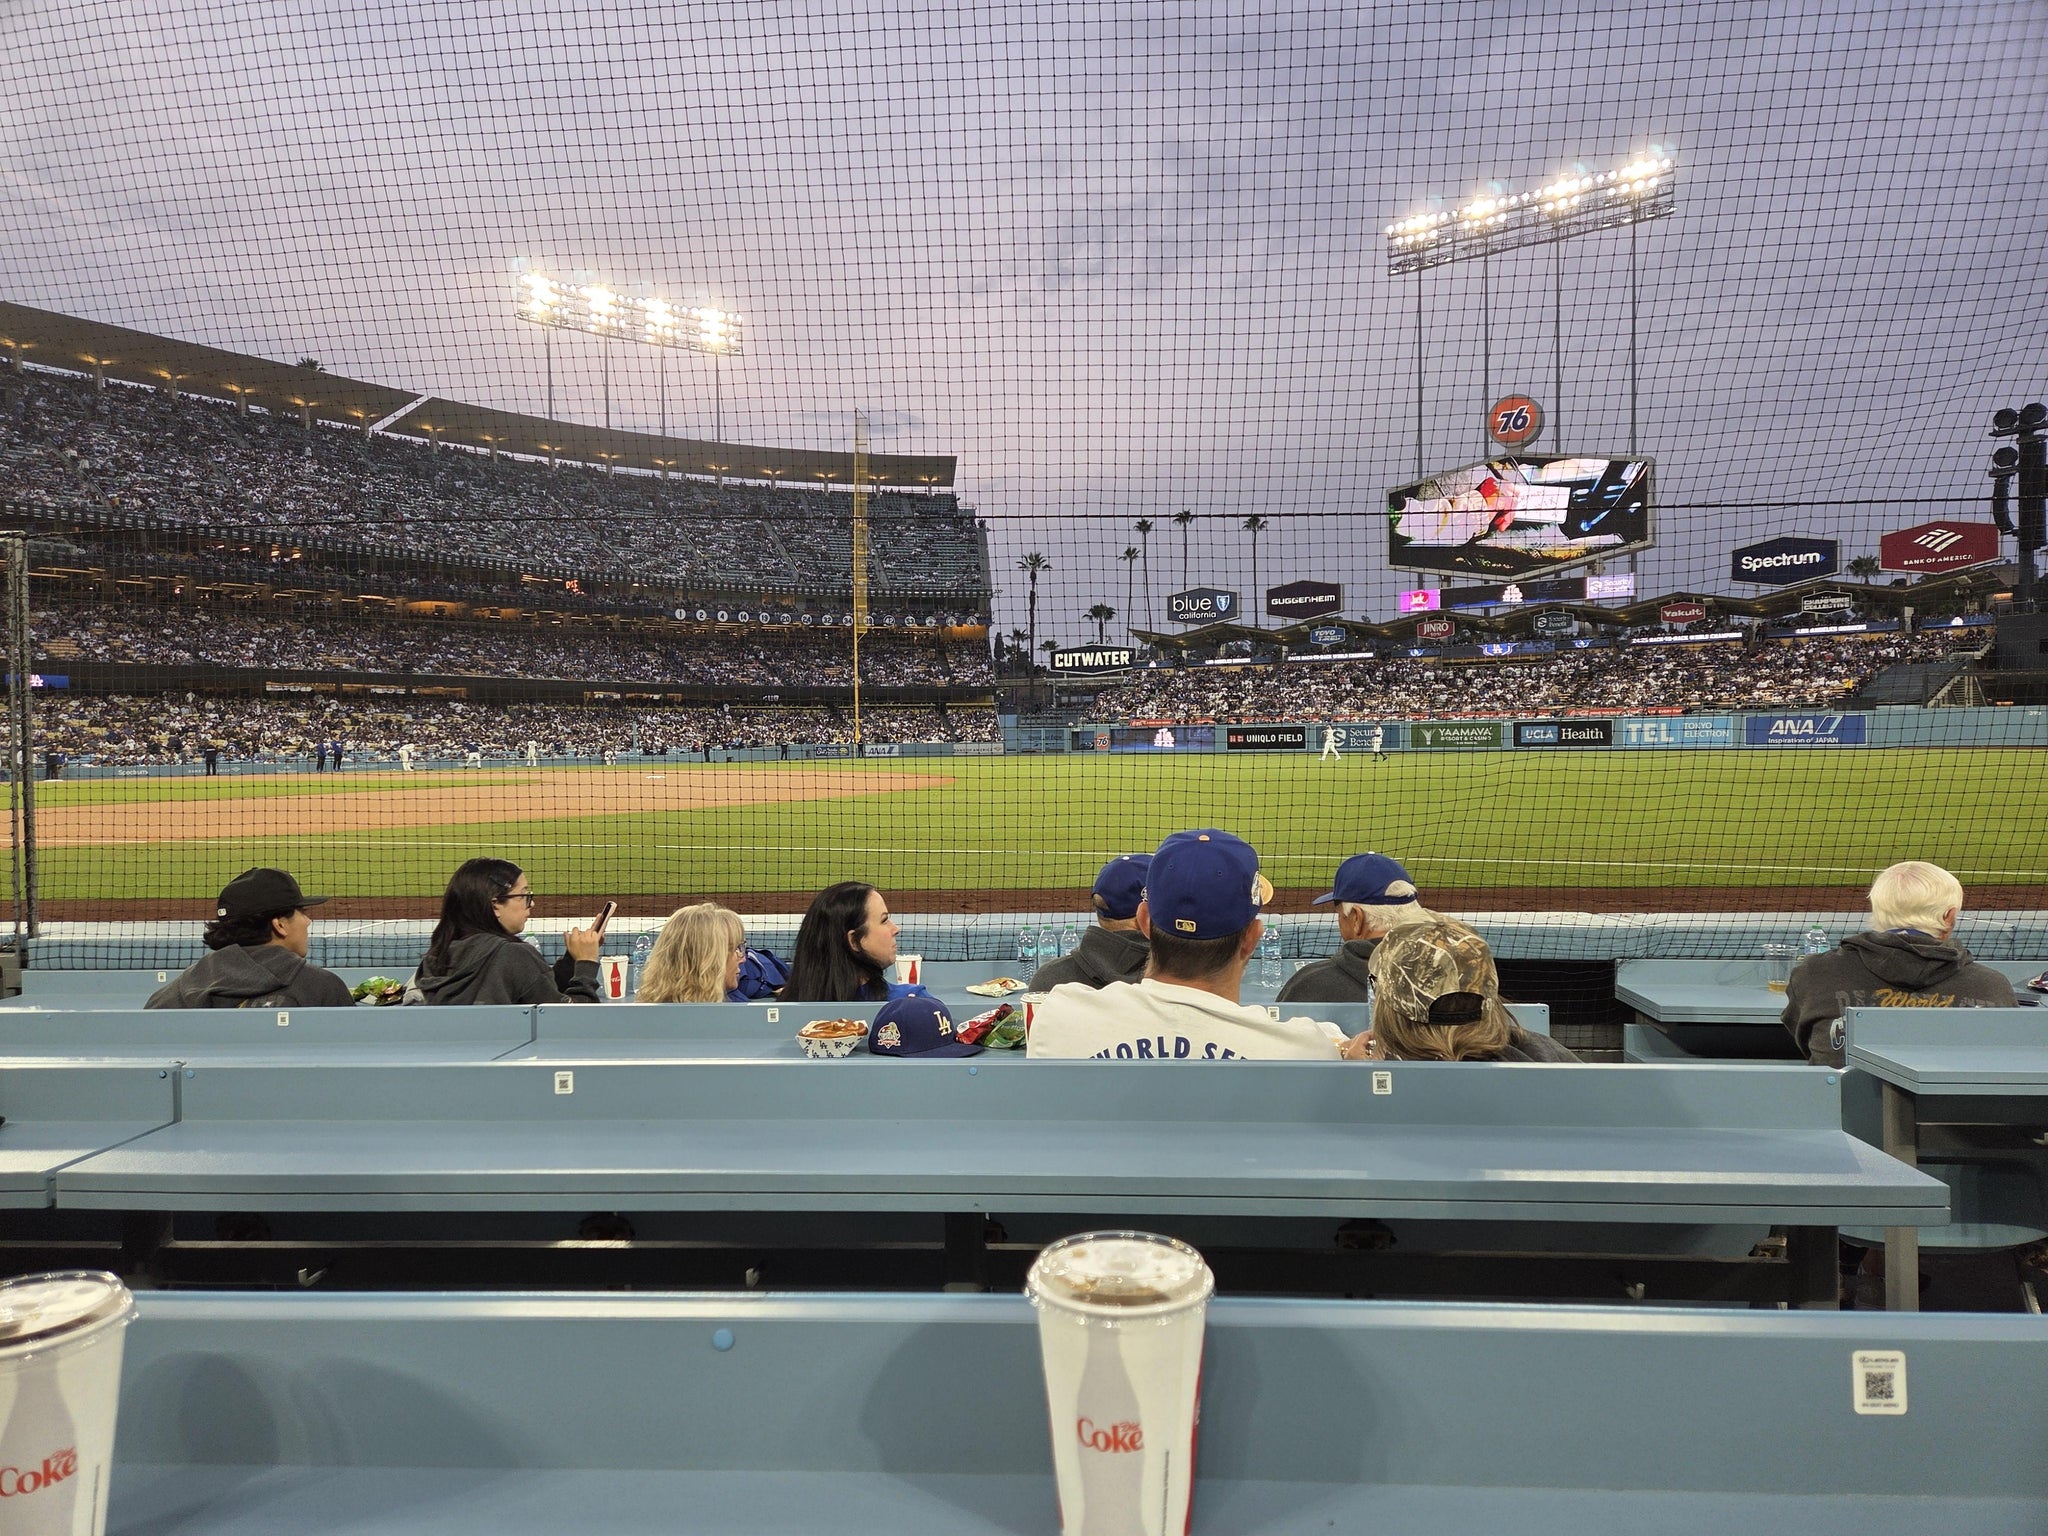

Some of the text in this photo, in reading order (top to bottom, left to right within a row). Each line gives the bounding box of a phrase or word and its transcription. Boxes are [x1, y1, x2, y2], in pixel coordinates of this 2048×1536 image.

[1497, 405, 1530, 434] 76
[1741, 552, 1820, 572] Spectrum
[1904, 554, 1973, 565] BANK OF AMERICA
[1172, 596, 1212, 612] blue
[1271, 595, 1336, 605] GUGGENHEIM
[1178, 611, 1217, 620] california
[1663, 608, 1704, 618] Yakult
[1423, 622, 1449, 635] JINRO
[1055, 650, 1130, 668] CUTWATER
[1684, 722, 1712, 730] TOKYO
[1769, 719, 1814, 735] ANA
[1246, 733, 1303, 743] UNIQLO FIELD
[1526, 730, 1554, 740] UCLA
[1561, 728, 1604, 740] Health
[1624, 724, 1674, 743] TEL
[1684, 729, 1729, 738] ELECTRON
[1096, 737, 1108, 746] 76
[933, 1010, 953, 1037] LA
[1201, 1042, 1248, 1059] SE
[1077, 1416, 1145, 1453] Coke
[0, 1454, 78, 1497] Coke
